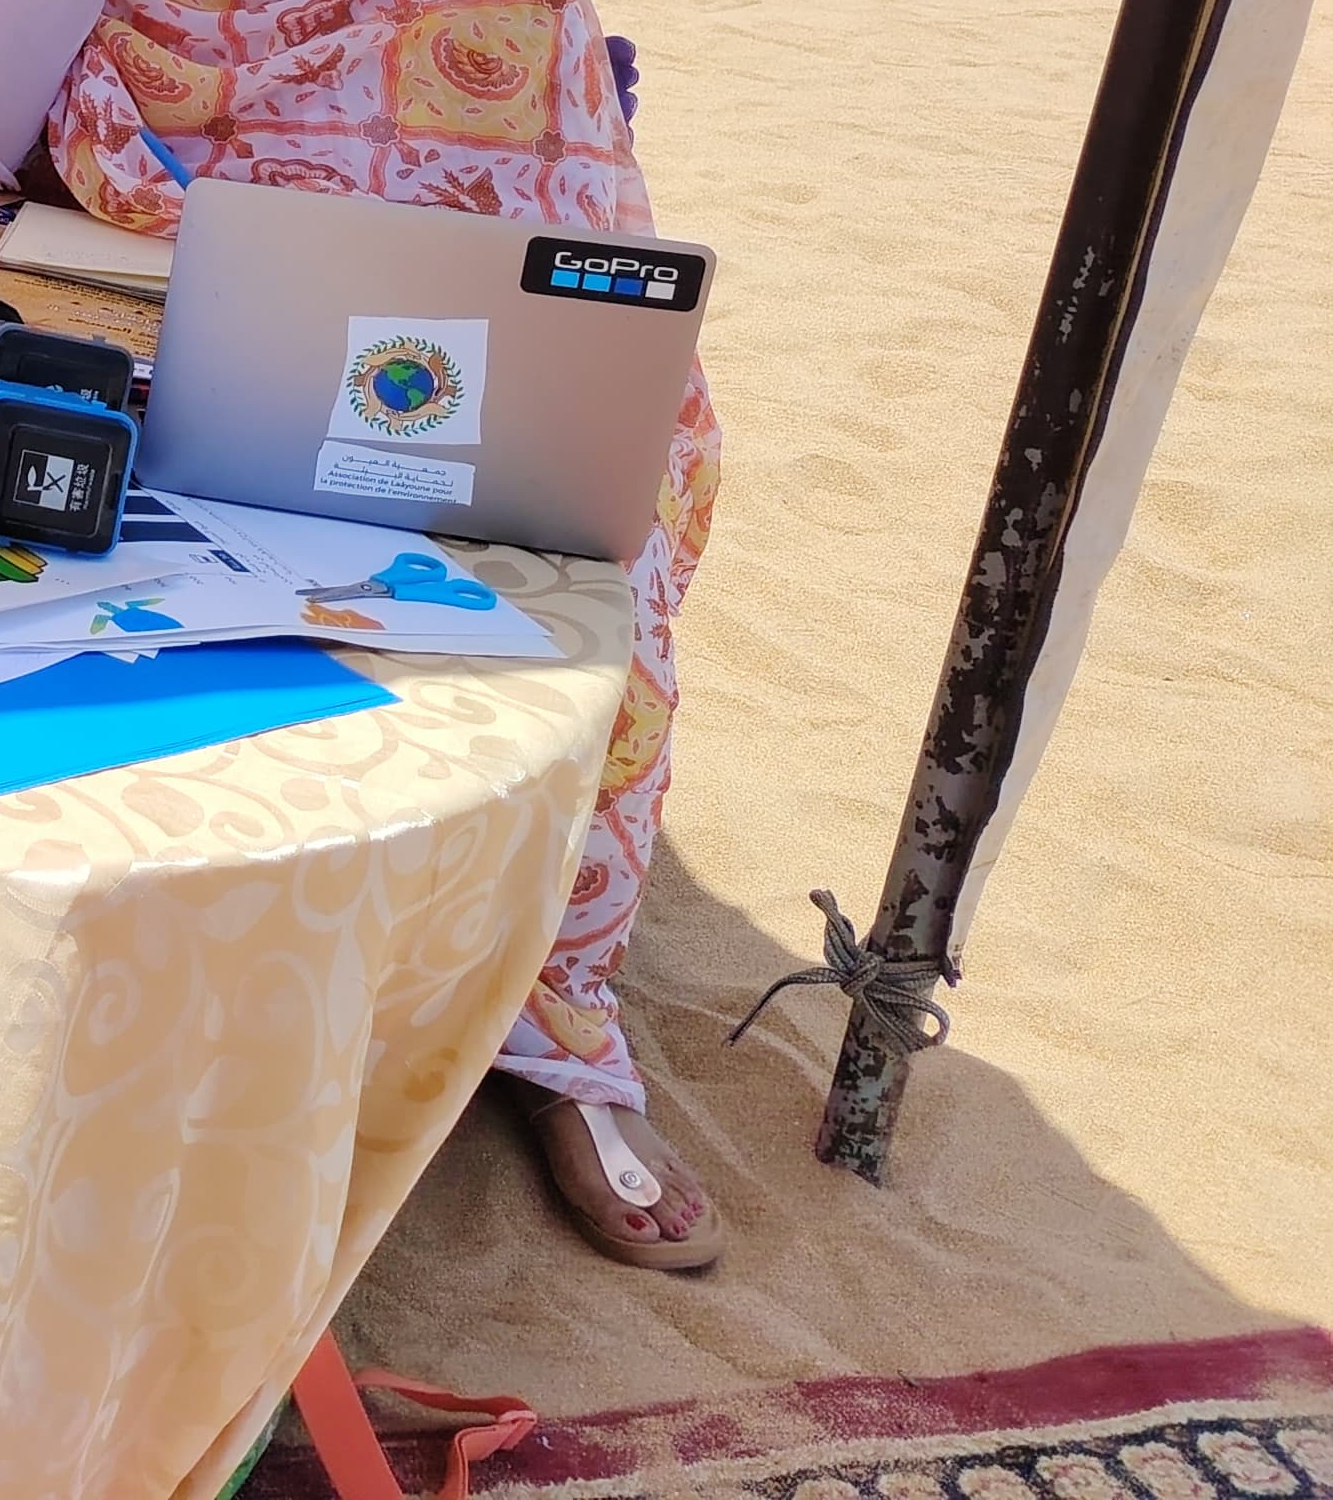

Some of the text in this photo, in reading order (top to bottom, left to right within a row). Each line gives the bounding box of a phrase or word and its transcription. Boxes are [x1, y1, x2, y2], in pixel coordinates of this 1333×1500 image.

[553, 251, 680, 282] GoPro
[327, 470, 376, 484] Association
[377, 477, 389, 486] de
[432, 486, 454, 496] pour
[329, 478, 374, 492] protection
[374, 484, 388, 494] de
